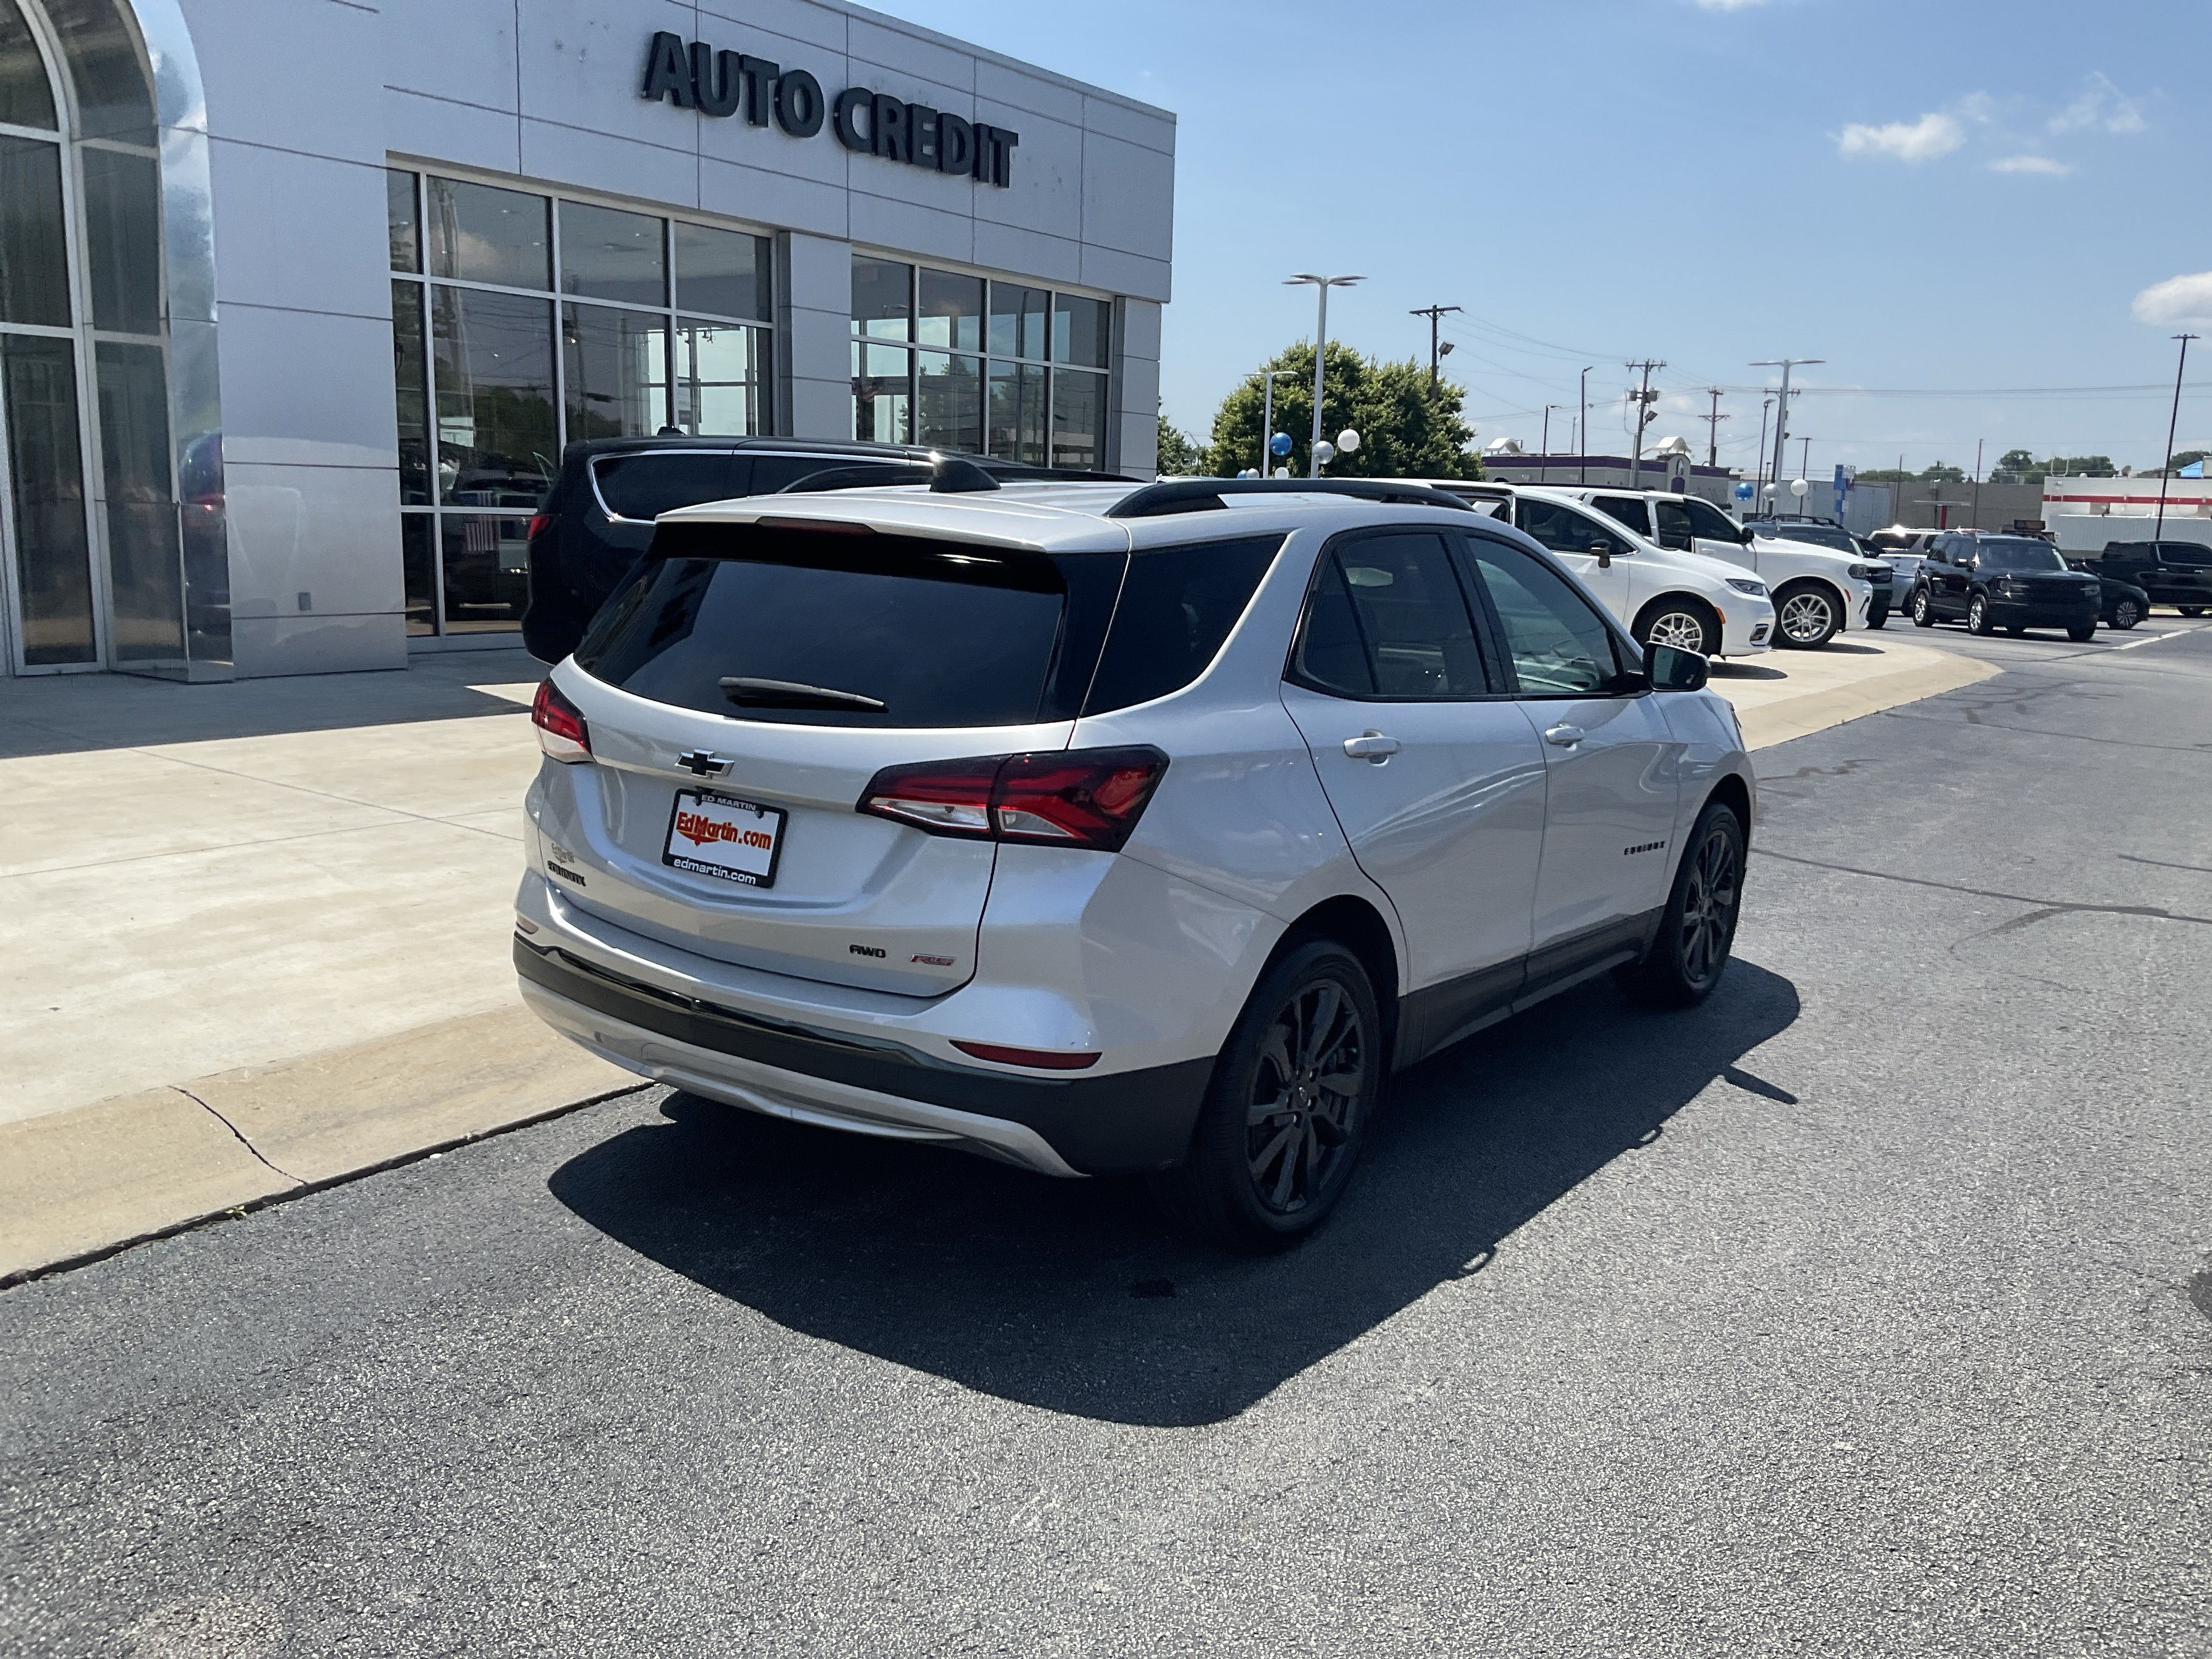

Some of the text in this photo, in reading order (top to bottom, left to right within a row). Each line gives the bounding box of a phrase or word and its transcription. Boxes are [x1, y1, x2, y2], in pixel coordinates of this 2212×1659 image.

[642, 31, 1019, 188] AUTO CREDIT
[717, 798, 756, 810] MARTIN
[676, 811, 772, 850] EdMartin.com
[674, 859, 756, 884] edmartin.com
[849, 944, 886, 958] AWD
